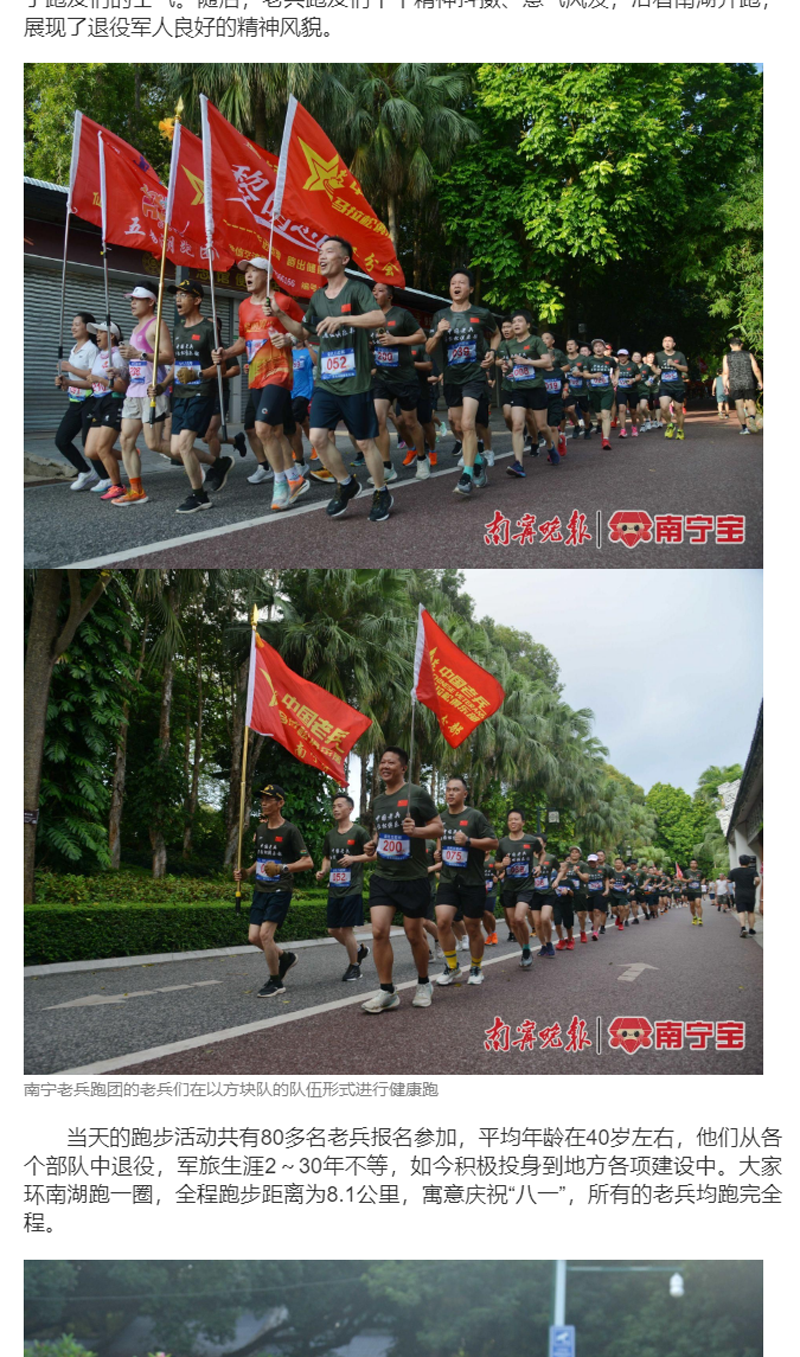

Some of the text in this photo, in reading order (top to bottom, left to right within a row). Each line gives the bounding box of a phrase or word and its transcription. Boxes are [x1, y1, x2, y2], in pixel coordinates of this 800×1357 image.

[24, 16, 331, 38] 展现了退役军人良好的精神风貌。
[326, 355, 347, 371] 052
[439, 666, 491, 715] 中国老兵
[434, 683, 481, 722] 拉松俱乐部
[281, 693, 351, 754] 中国老兵
[383, 839, 403, 853] 200
[446, 850, 462, 861] 075
[24, 1082, 439, 1098] 南宁老兵跑团的老兵们在以方块队的队伍形式进行健康跑
[24, 1212, 53, 1233] 程。
